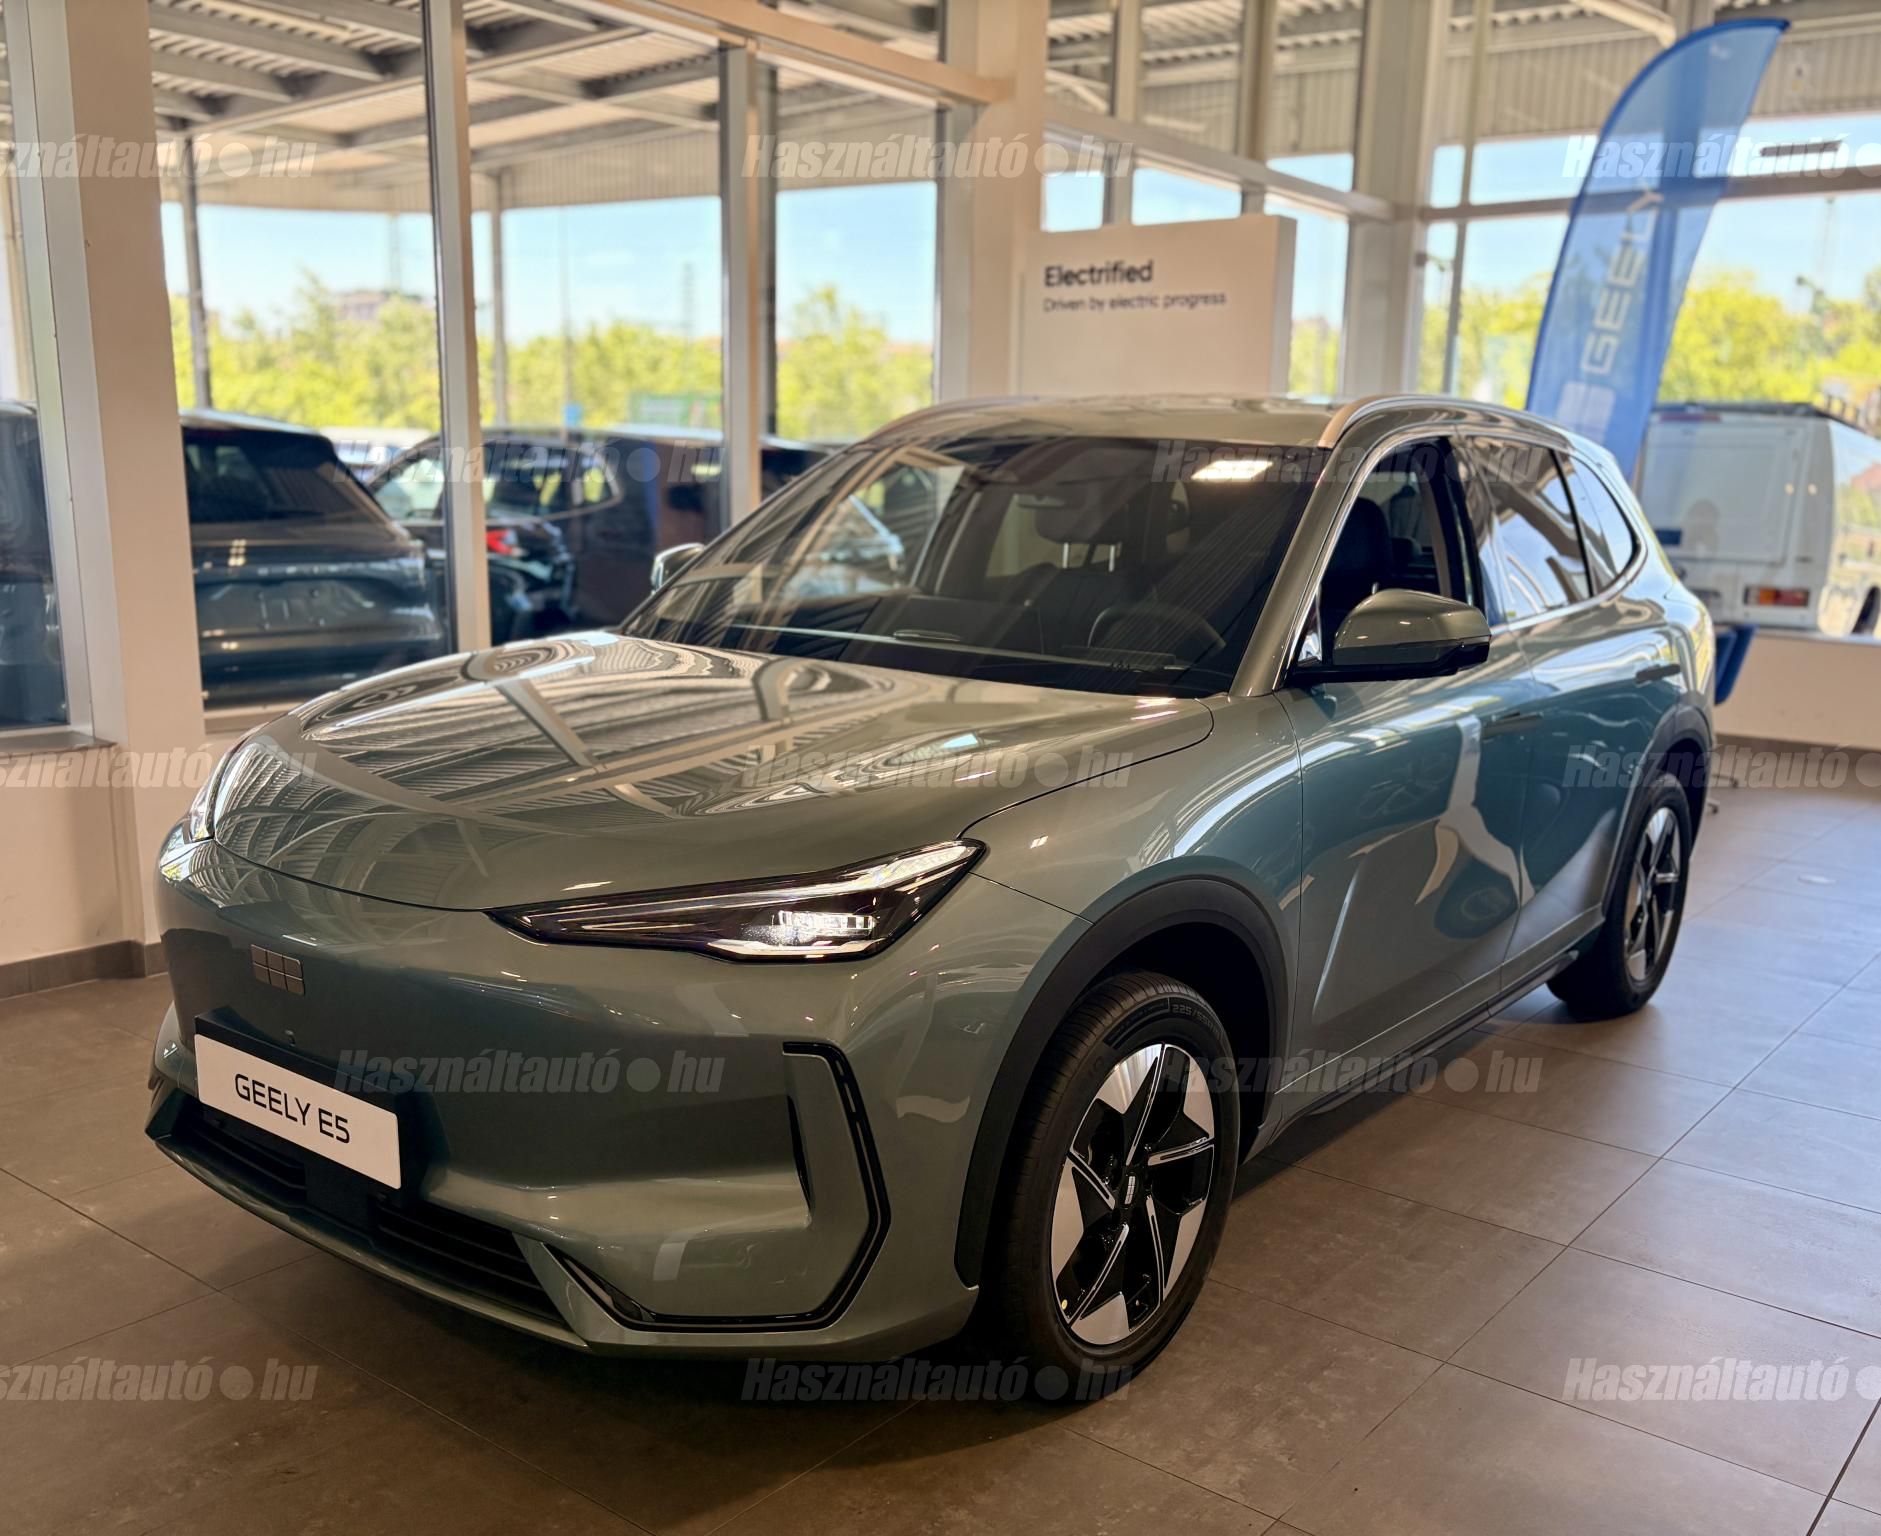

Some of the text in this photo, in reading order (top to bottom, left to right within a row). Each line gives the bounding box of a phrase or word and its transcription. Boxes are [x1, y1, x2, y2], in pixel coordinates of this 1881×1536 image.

[1044, 259, 1154, 288] Electrified
[1579, 186, 1664, 377] GEELY
[1043, 293, 1226, 313] Driven by electric progress
[235, 1073, 350, 1144] GEELY E5
